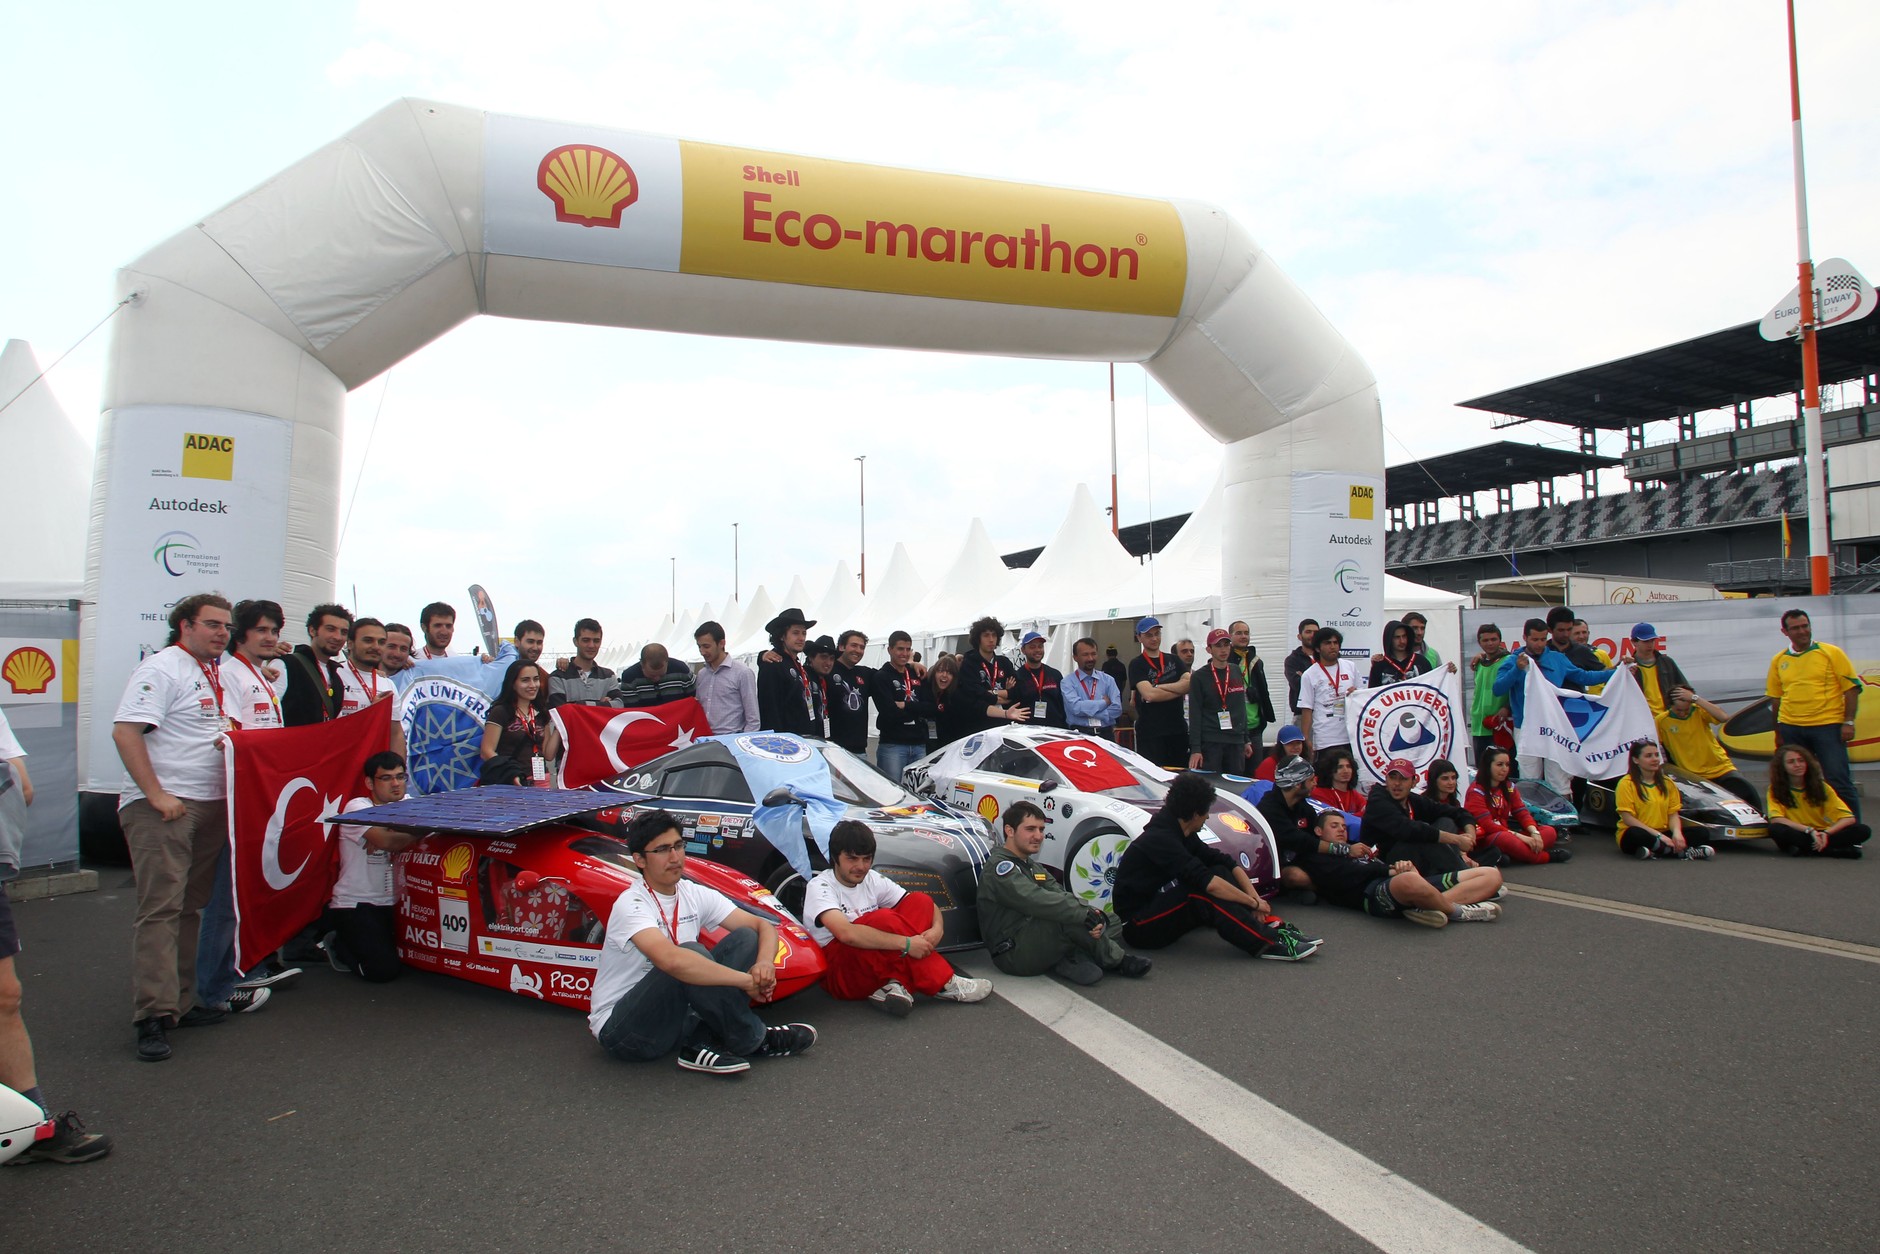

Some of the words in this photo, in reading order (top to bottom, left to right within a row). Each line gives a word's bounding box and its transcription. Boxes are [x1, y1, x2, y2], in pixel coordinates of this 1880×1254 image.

[742, 165, 800, 187] Shell
[185, 434, 233, 453] ADAC
[1351, 486, 1374, 499] ADAC
[148, 497, 228, 514] Autodesk
[1328, 533, 1373, 546] Autodesk
[173, 552, 221, 561] International
[186, 560, 220, 569] Transport
[1648, 591, 1679, 601] Autocars
[140, 613, 158, 621] THE
[1732, 808, 1758, 817] 112
[486, 846, 514, 855] Kaporta
[412, 852, 441, 867] VAKFI
[411, 903, 436, 917] HEXAGON
[442, 914, 468, 933] 409
[488, 923, 540, 935] elektrikport.com
[405, 925, 439, 949] AKS
[475, 964, 500, 974] Mahindra
[550, 970, 593, 992] PRO
